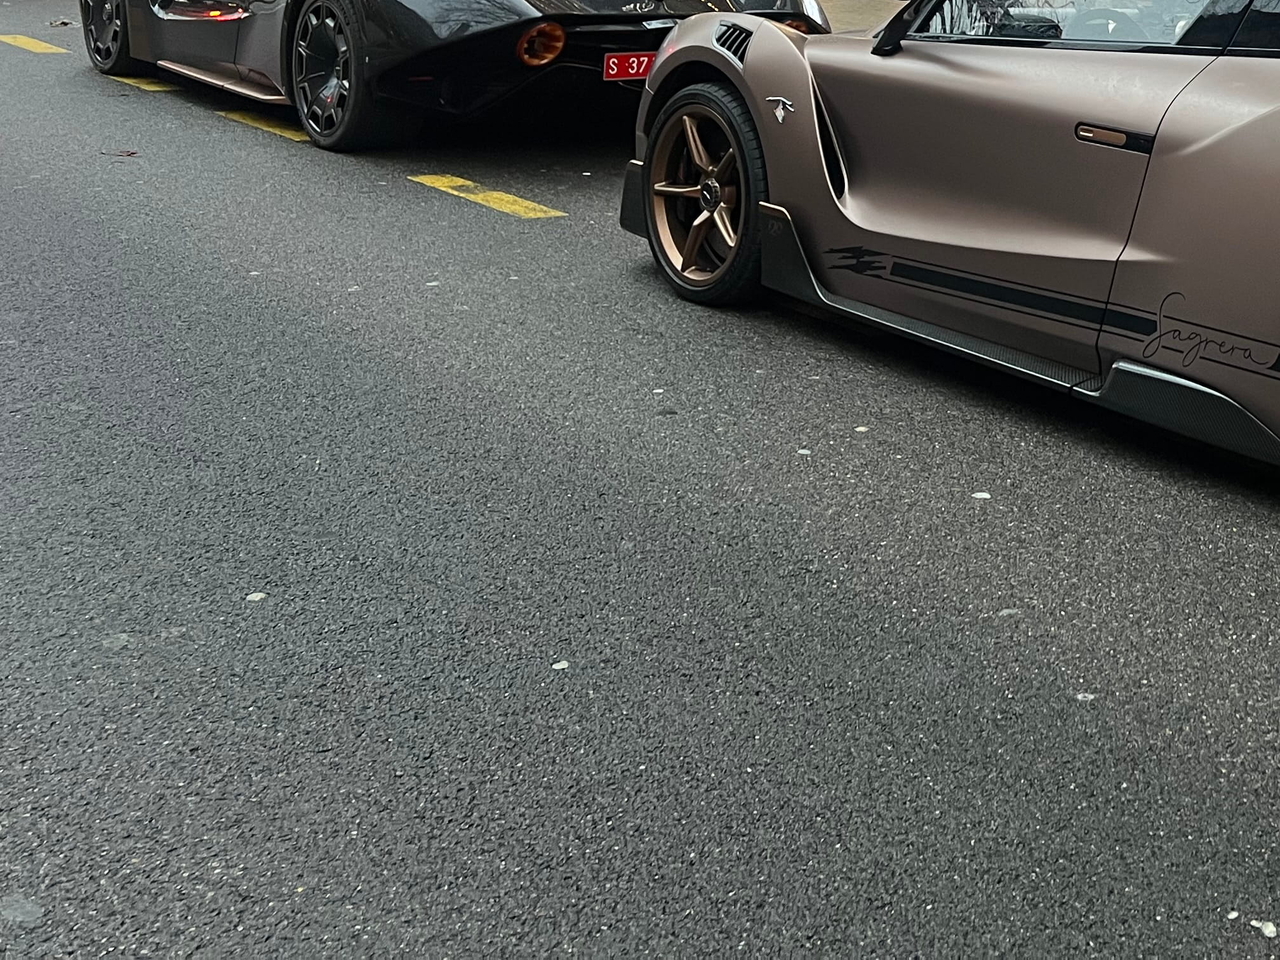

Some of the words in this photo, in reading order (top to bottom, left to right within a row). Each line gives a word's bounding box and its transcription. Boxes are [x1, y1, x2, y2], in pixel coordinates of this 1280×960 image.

[609, 58, 618, 75] S
[628, 57, 655, 74] 37
[1142, 291, 1269, 368] Sagrera
